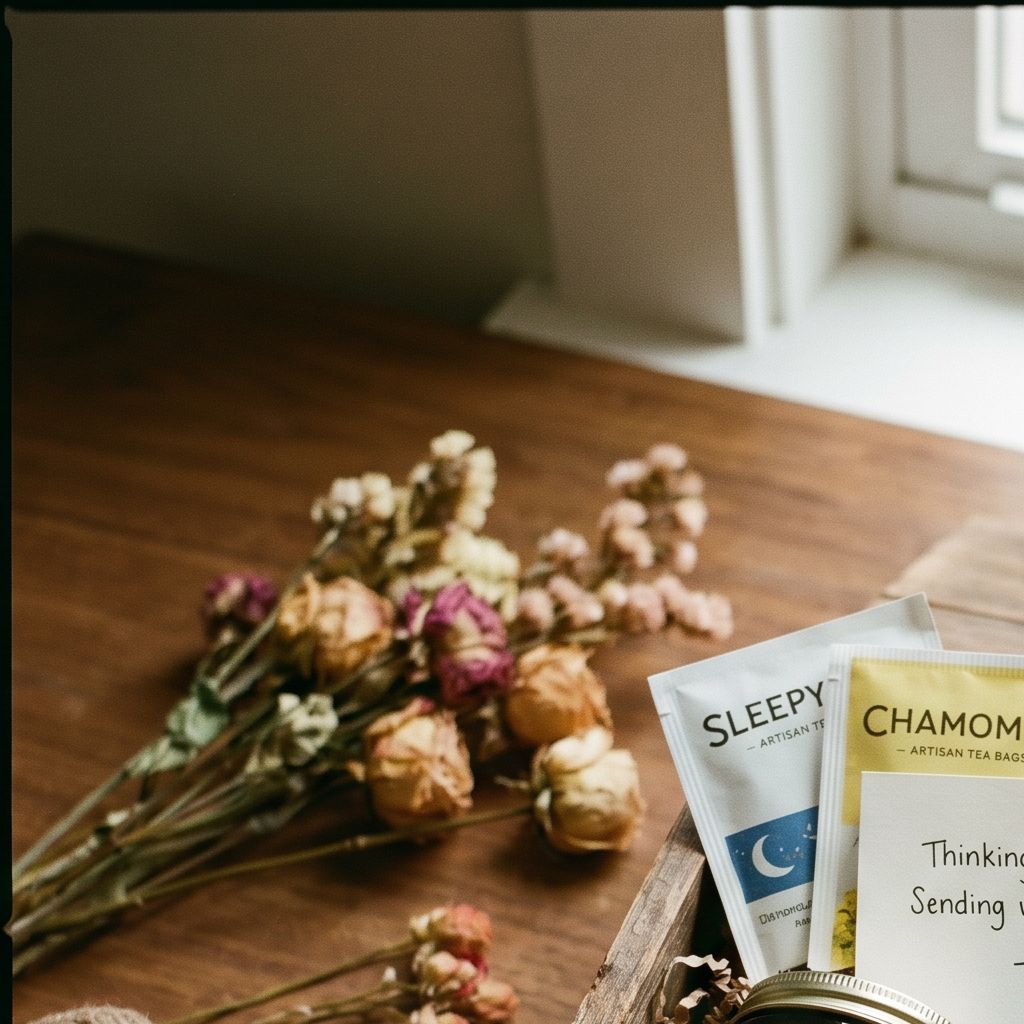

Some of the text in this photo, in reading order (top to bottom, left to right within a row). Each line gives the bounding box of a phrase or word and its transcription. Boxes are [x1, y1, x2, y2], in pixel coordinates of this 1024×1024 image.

[702, 680, 824, 748] SLEEPY
[760, 724, 810, 749] ARTISAN
[910, 745, 963, 758] ARTISAN
[967, 749, 990, 761] TEA
[910, 886, 1005, 931] Sending
